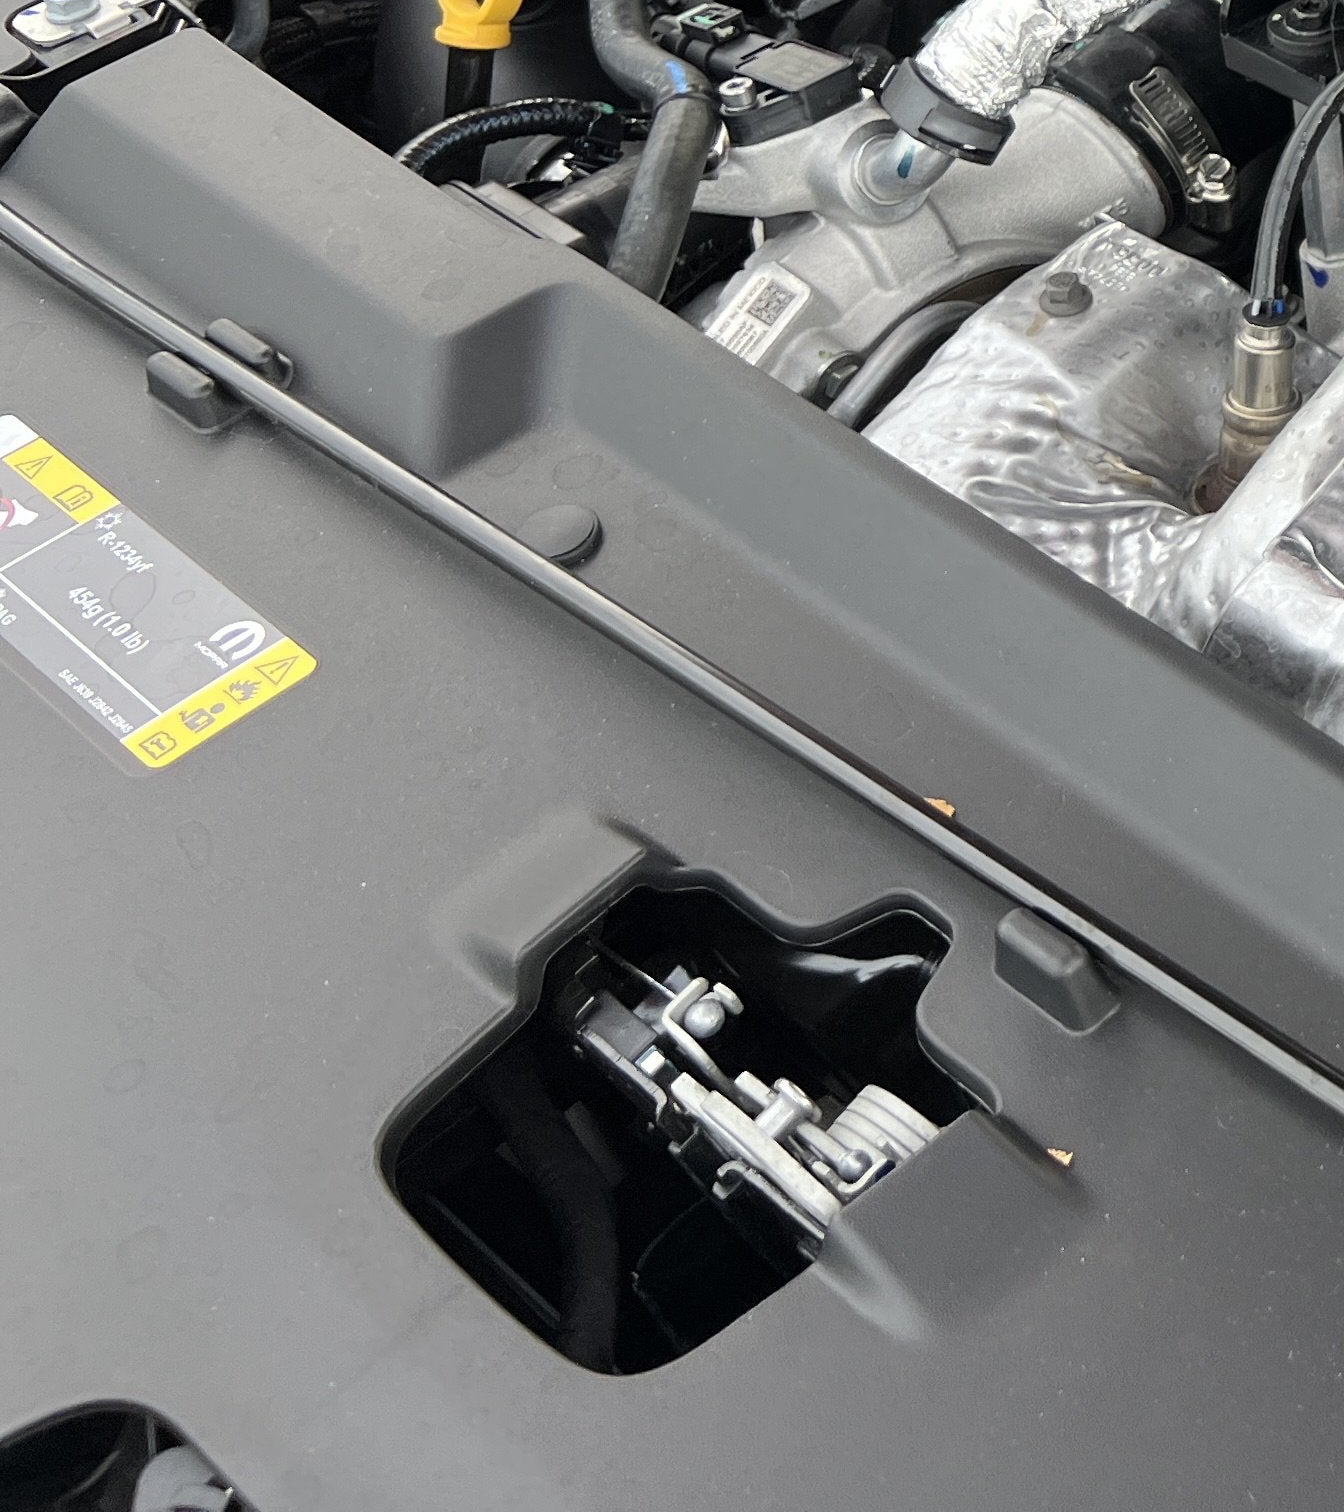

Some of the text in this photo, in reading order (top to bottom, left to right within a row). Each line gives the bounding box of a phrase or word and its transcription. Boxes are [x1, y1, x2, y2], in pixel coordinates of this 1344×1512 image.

[98, 530, 154, 574] R-1234yf
[68, 586, 149, 655] 454g (1.0 lb)
[194, 640, 229, 670] MOPAR
[55, 668, 80, 685] SAE
